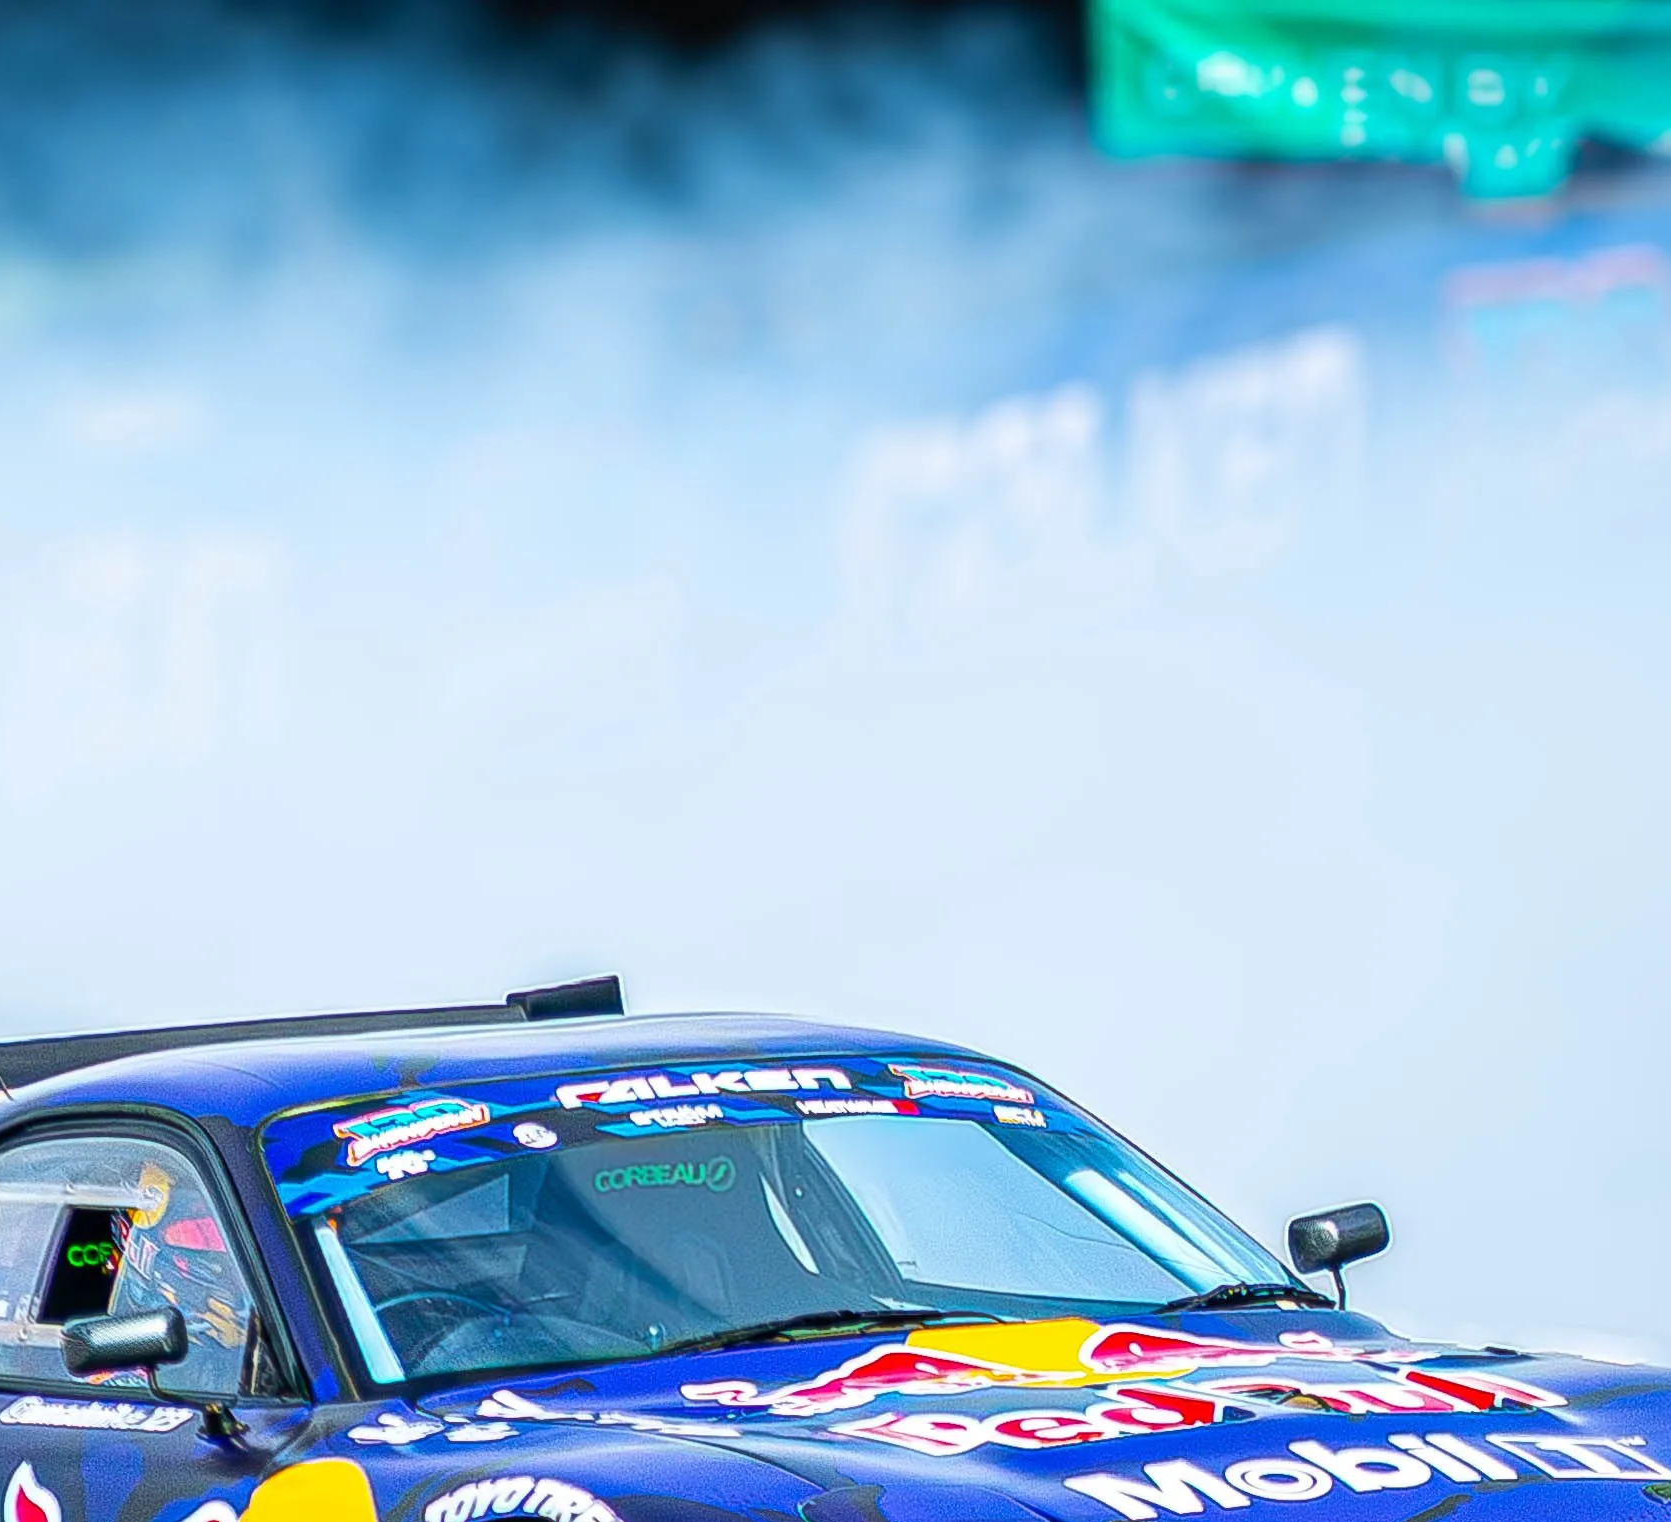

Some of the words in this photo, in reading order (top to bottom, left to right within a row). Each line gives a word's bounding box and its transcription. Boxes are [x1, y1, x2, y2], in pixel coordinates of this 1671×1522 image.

[555, 1068, 852, 1110] FALKEN
[594, 1161, 707, 1193] CORBEAU
[1063, 1434, 1520, 1521] Mobil
